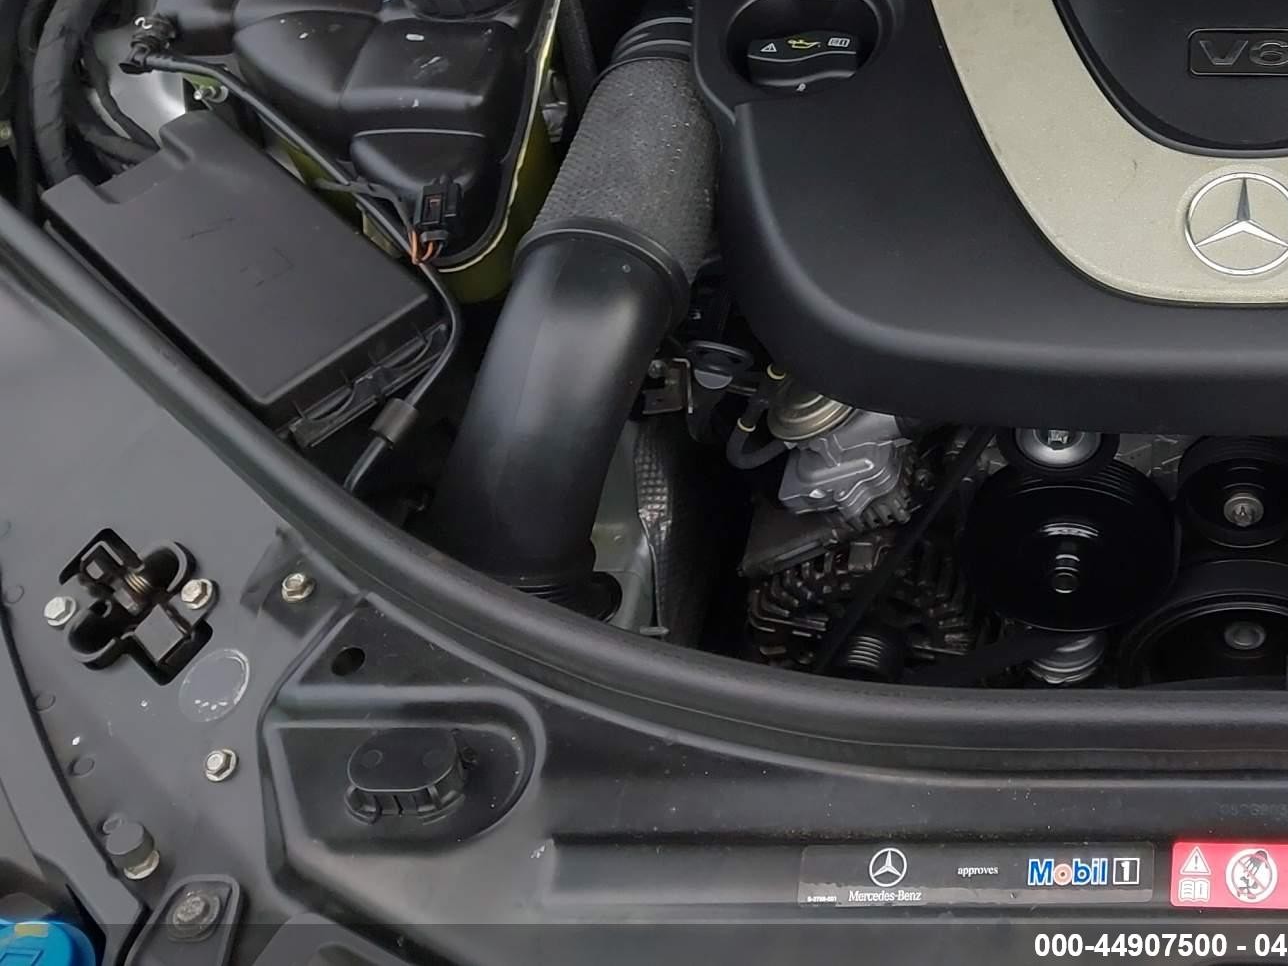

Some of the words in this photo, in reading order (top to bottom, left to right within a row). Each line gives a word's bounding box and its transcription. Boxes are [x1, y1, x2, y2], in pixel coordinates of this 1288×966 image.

[957, 866, 999, 877] approves
[1027, 858, 1108, 886] Mobil
[848, 890, 922, 902] Mercedes-Benz
